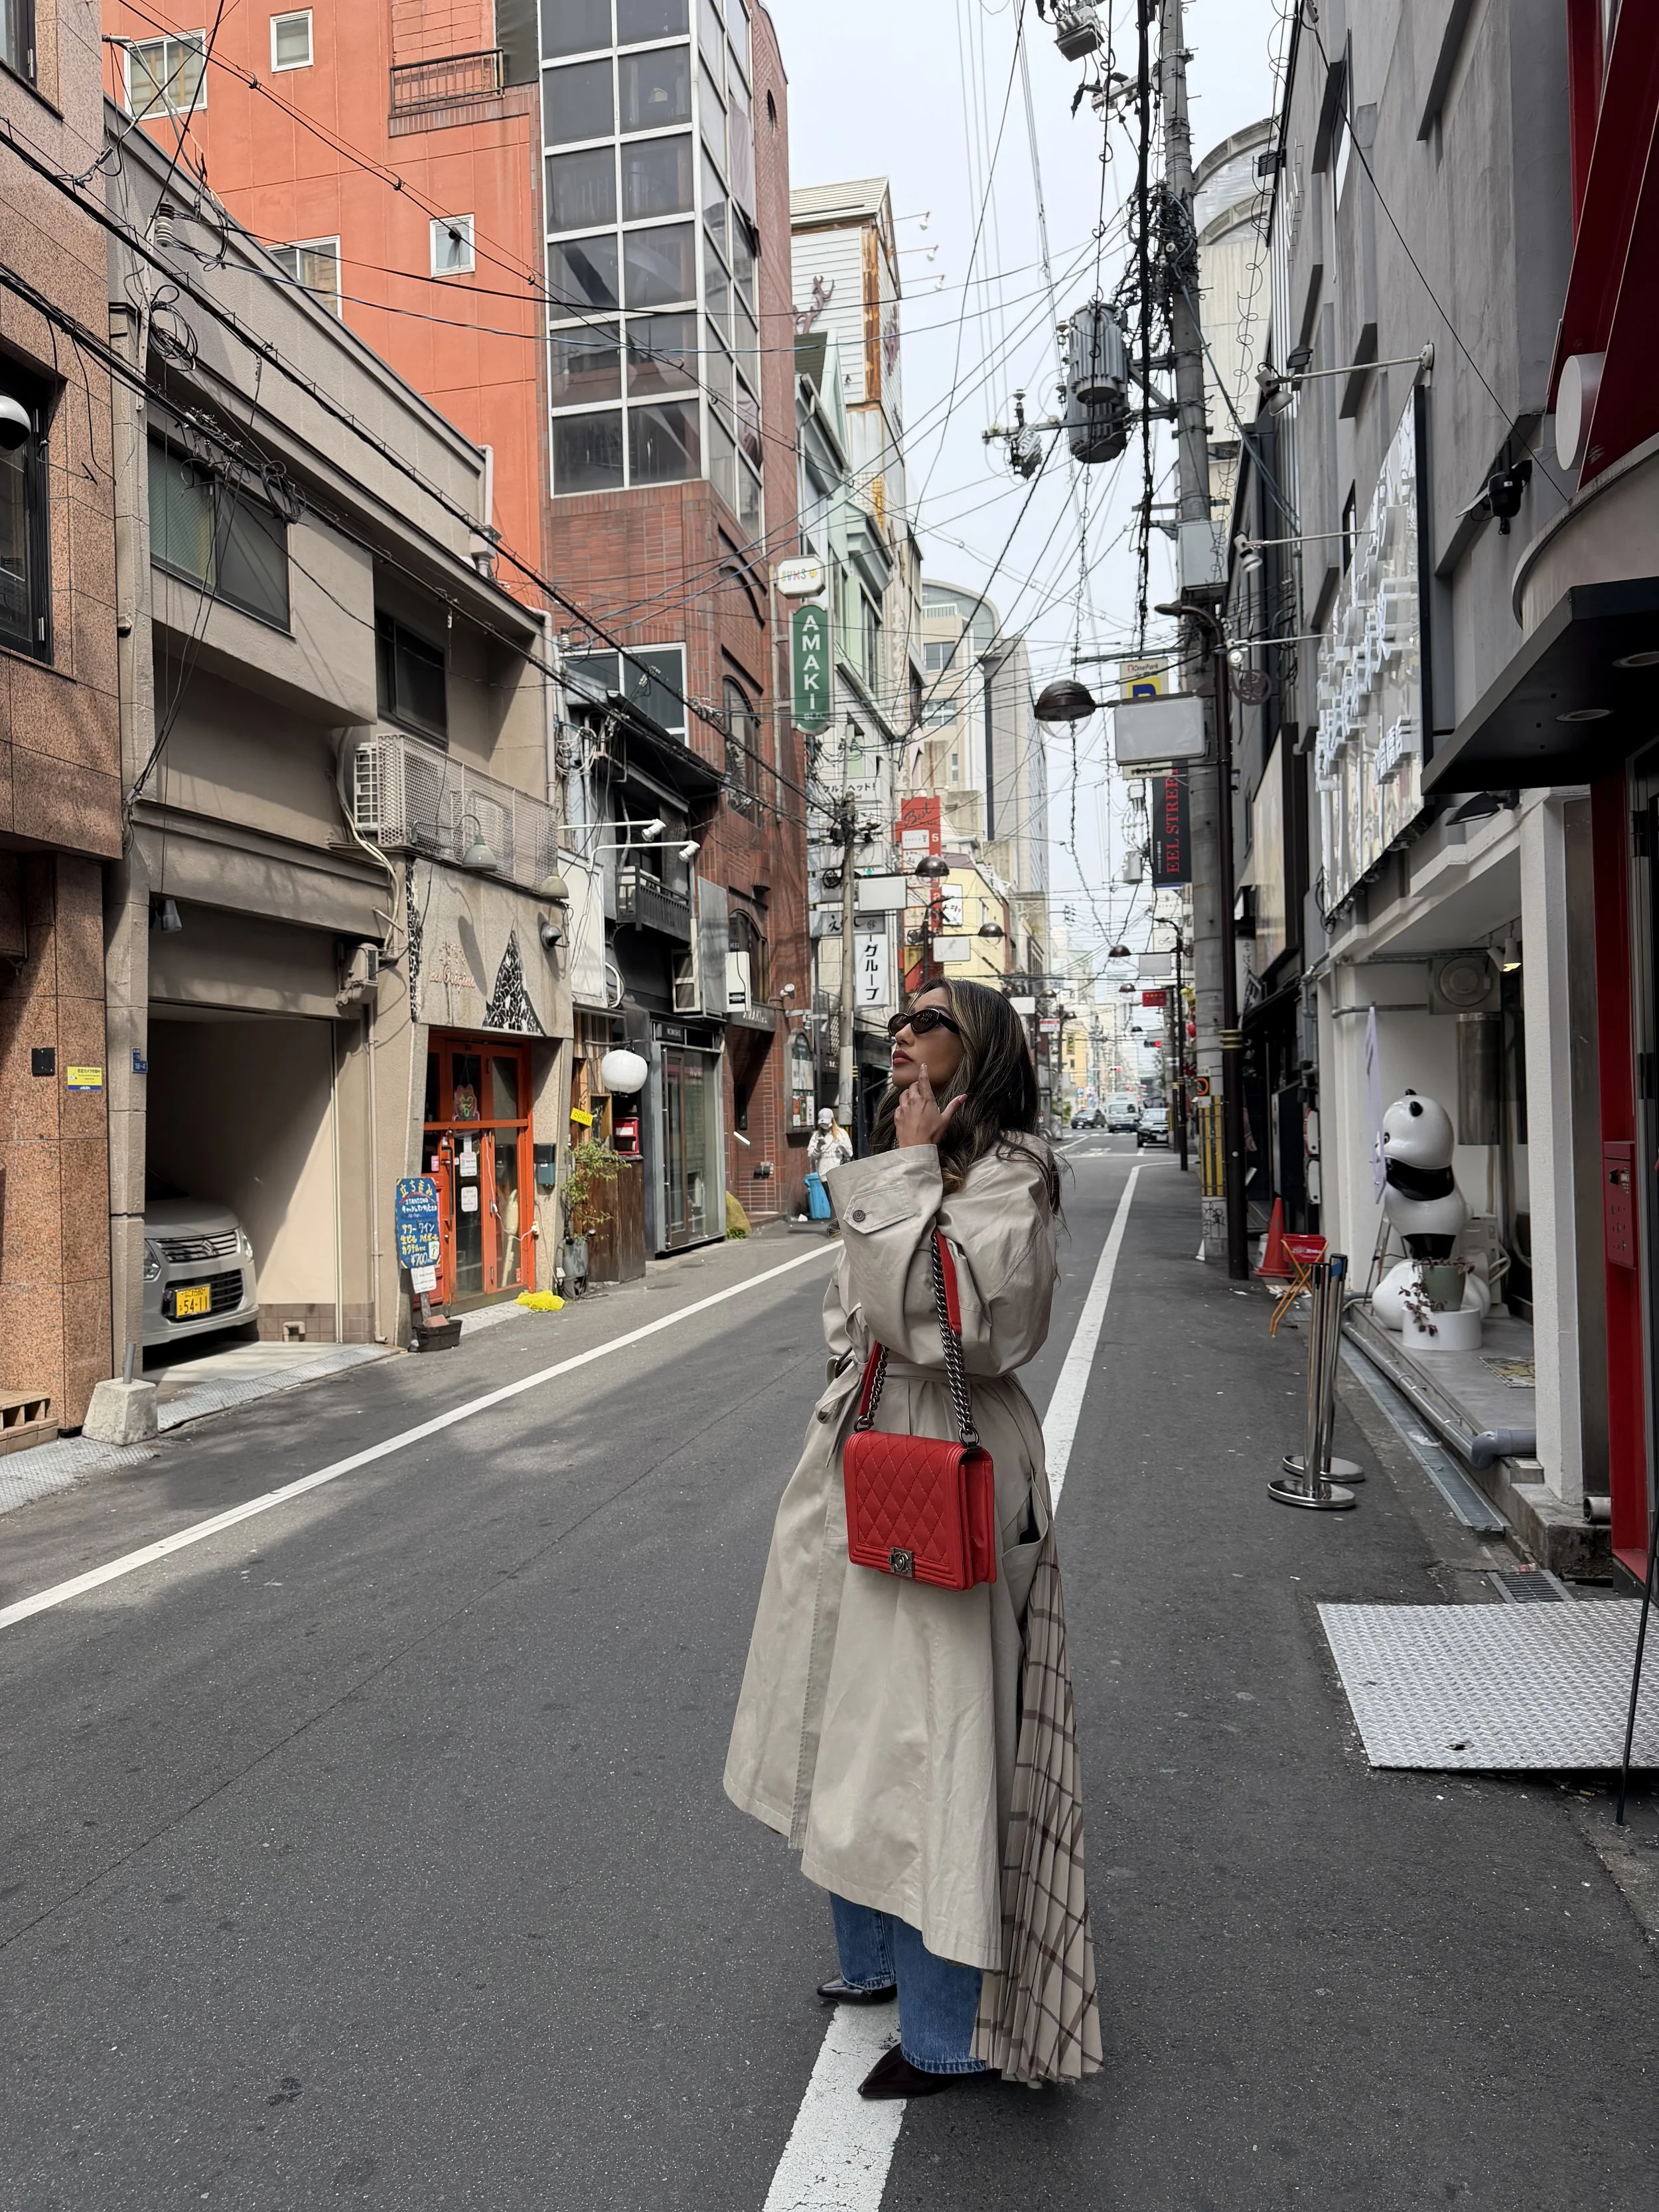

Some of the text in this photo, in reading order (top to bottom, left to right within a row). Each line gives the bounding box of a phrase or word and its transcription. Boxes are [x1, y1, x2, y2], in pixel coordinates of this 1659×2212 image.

[802, 615, 821, 709] AMAKI
[1166, 768, 1180, 873] EEL STREE
[931, 833, 939, 842] 5
[573, 1112, 590, 1122] open
[419, 1222, 435, 1234] ワイン
